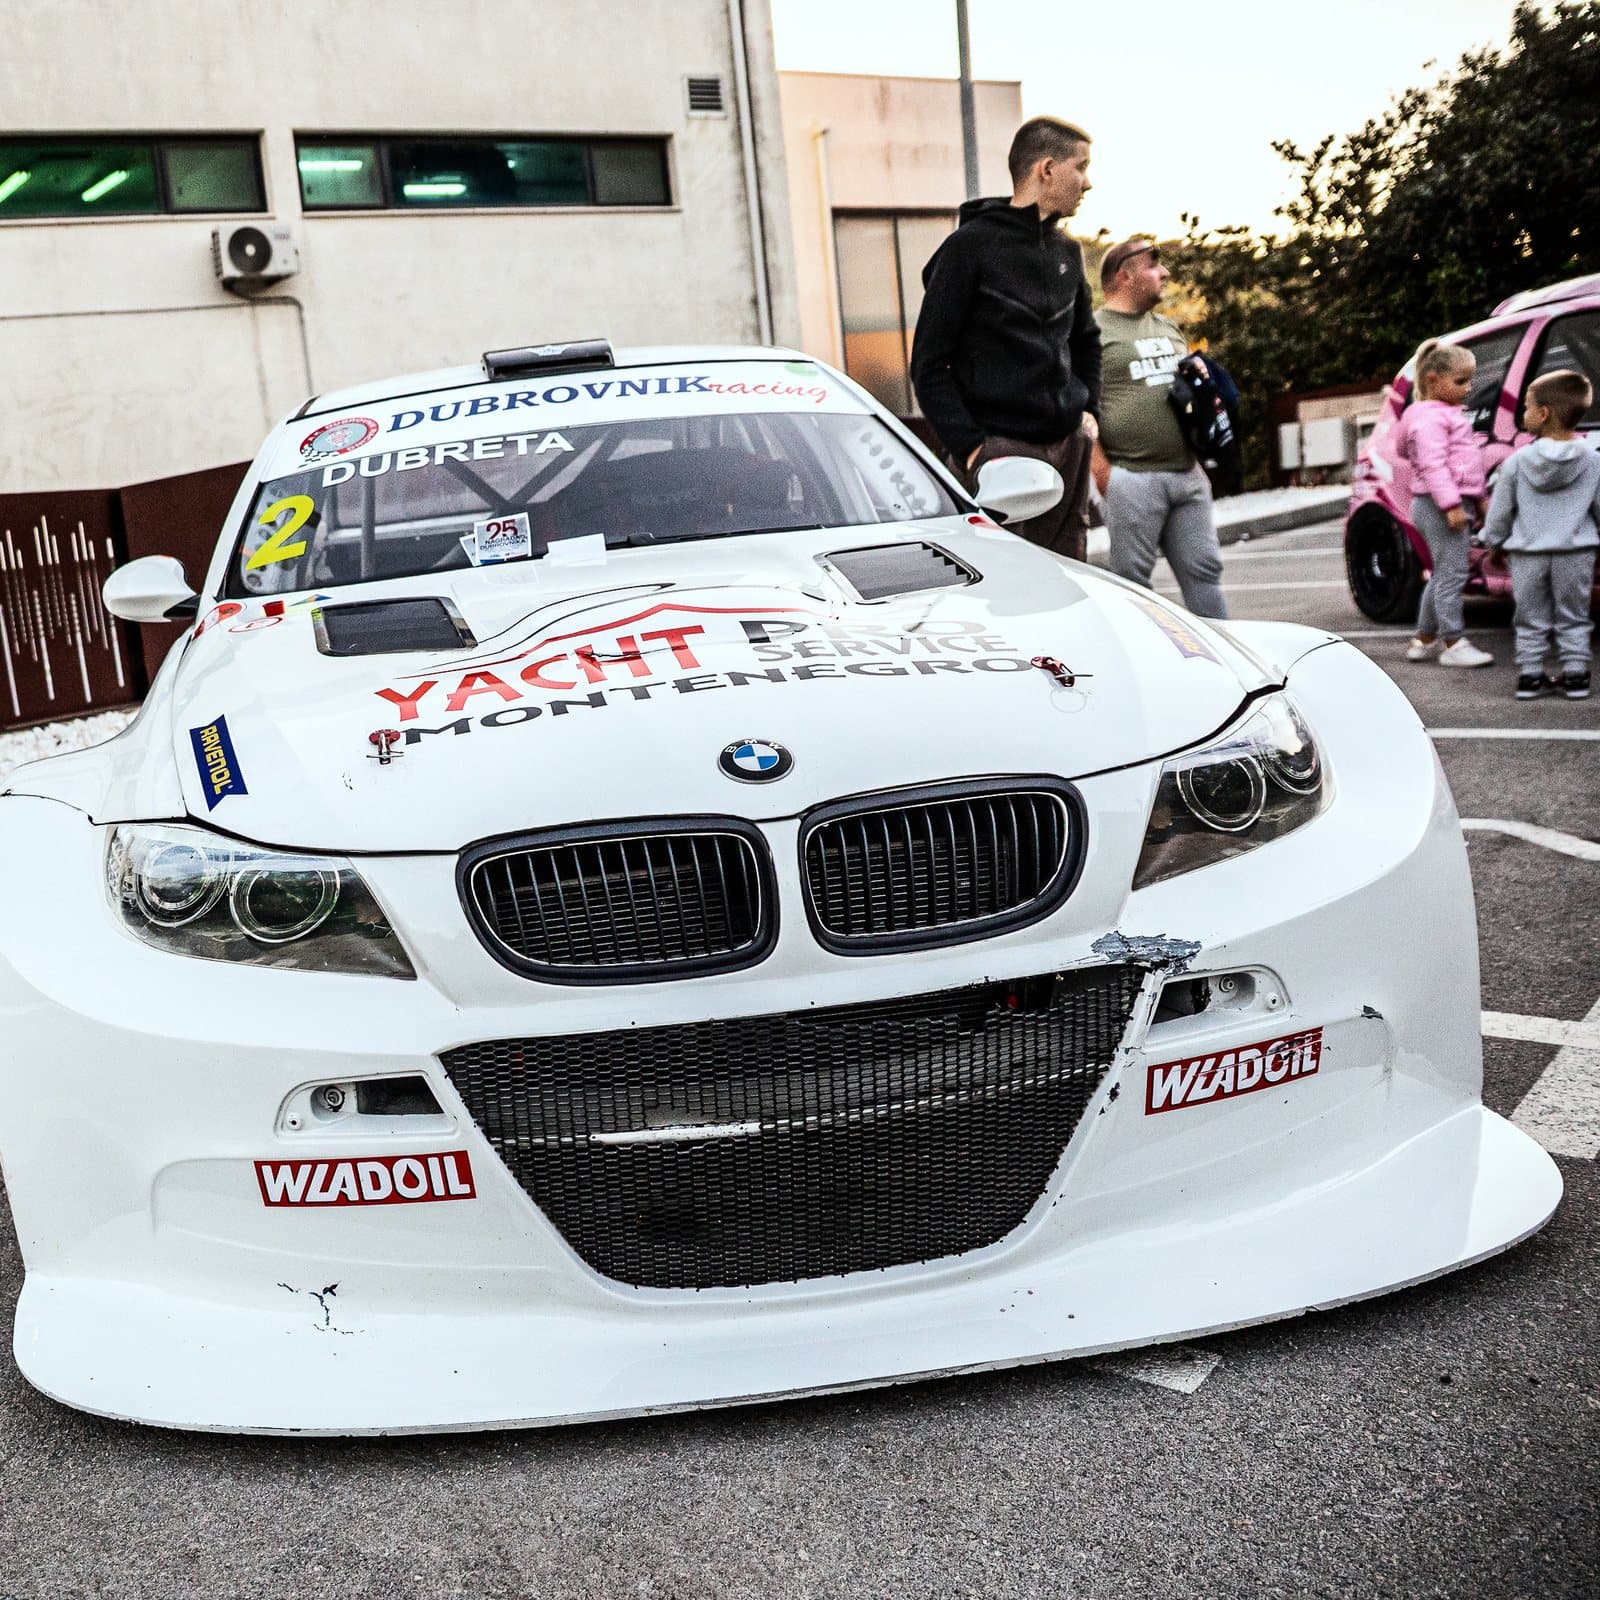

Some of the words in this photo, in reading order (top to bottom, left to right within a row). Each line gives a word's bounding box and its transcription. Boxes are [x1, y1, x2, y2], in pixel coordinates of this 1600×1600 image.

[387, 376, 711, 433] DUBROVNIK
[708, 380, 827, 404] racing
[322, 432, 575, 488] DUBRETA
[245, 494, 315, 571] 2
[374, 624, 705, 722] YACHT
[739, 620, 986, 644] PRO
[752, 634, 1018, 662] SERVICE
[400, 657, 1033, 745] MONTENEGRO
[200, 725, 232, 795] RAVENOL
[725, 739, 783, 753] BMW
[1151, 1033, 1318, 1110] WLADOIL
[261, 1155, 471, 1203] WLADOIL
